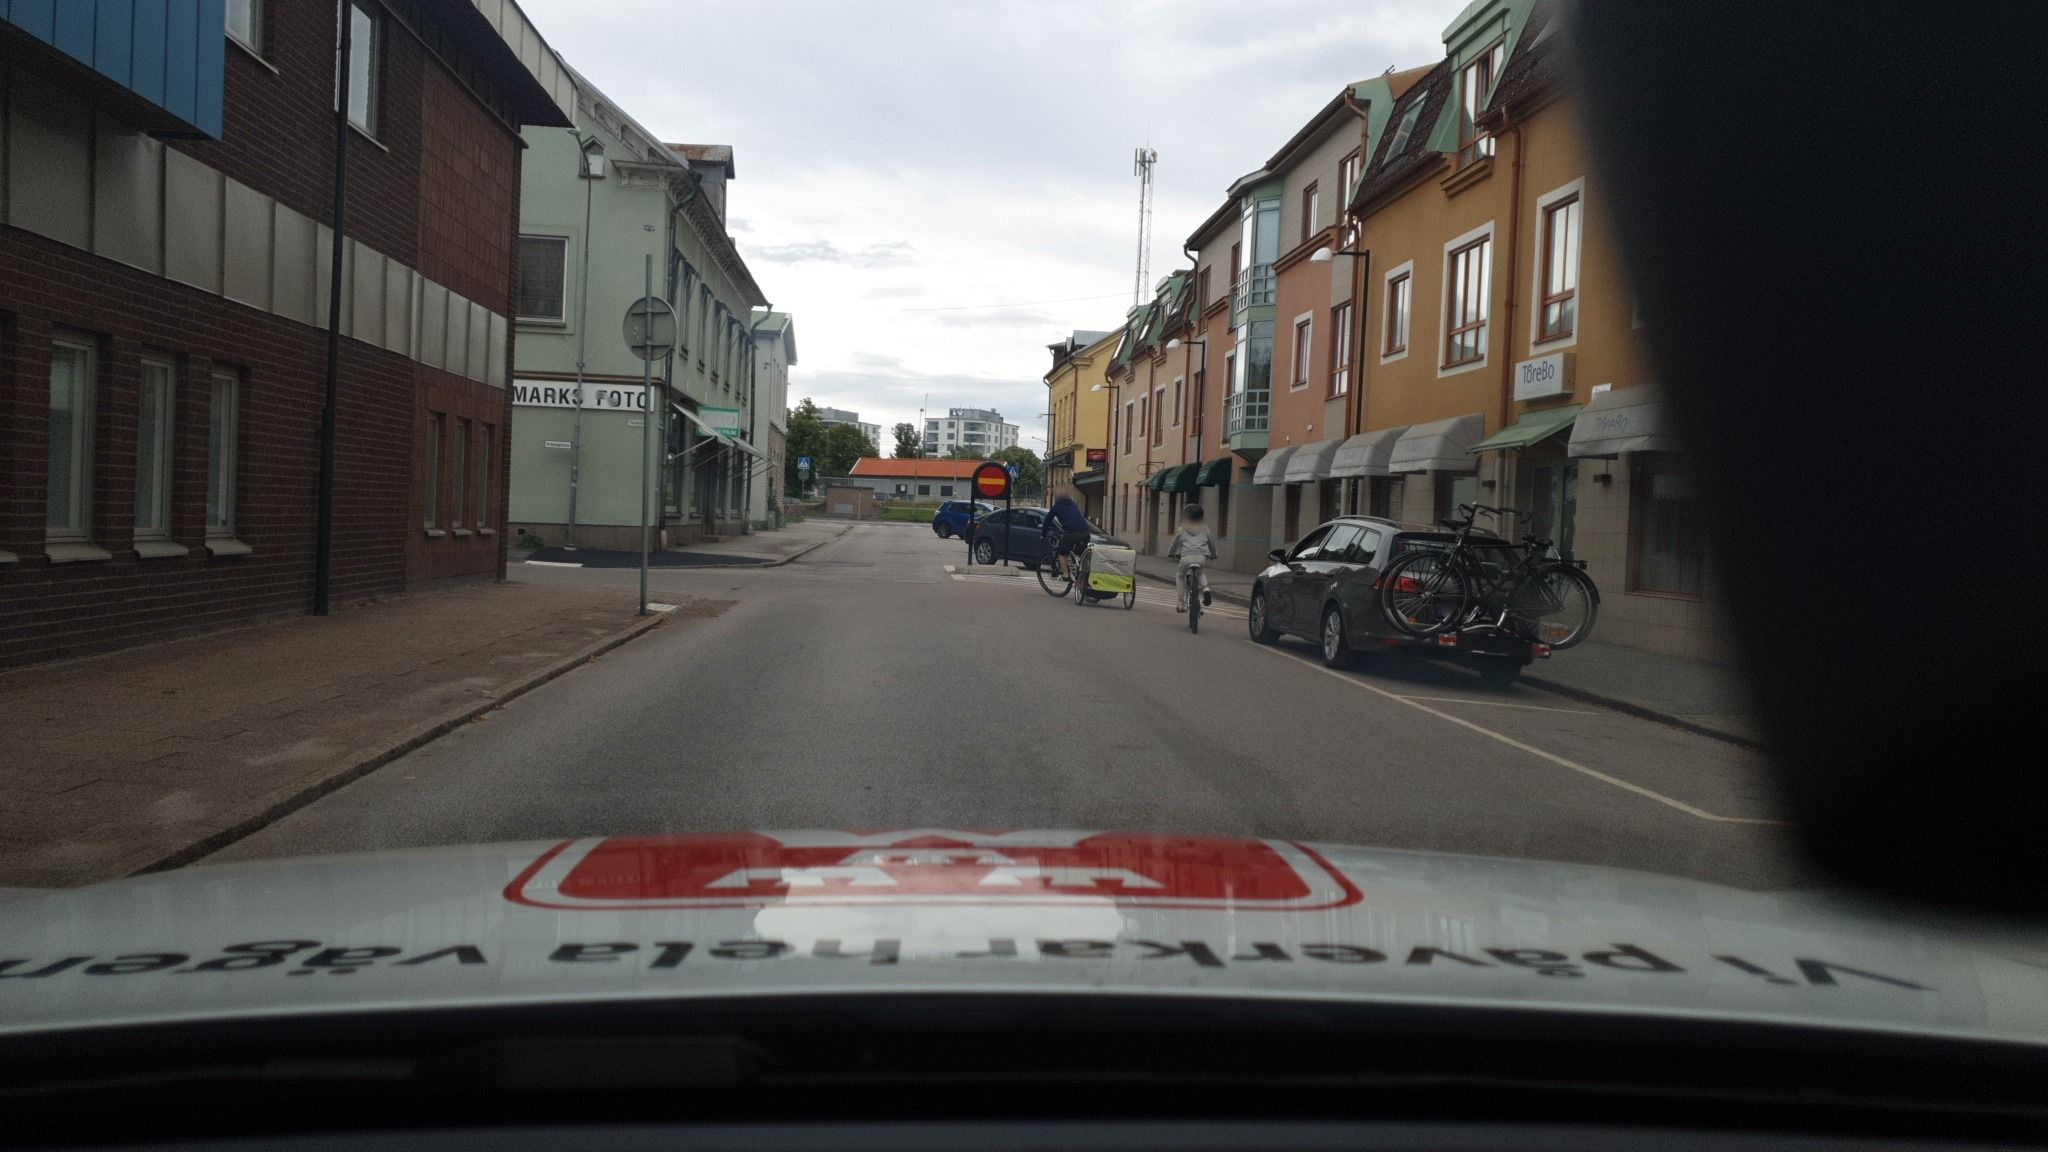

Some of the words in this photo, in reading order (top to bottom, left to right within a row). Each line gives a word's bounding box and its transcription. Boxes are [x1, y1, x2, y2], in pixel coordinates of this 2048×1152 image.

[0, 940, 487, 978] vägen
[549, 941, 902, 968] hela
[957, 941, 1686, 979] påverkar
[1712, 954, 1938, 991] Vi
